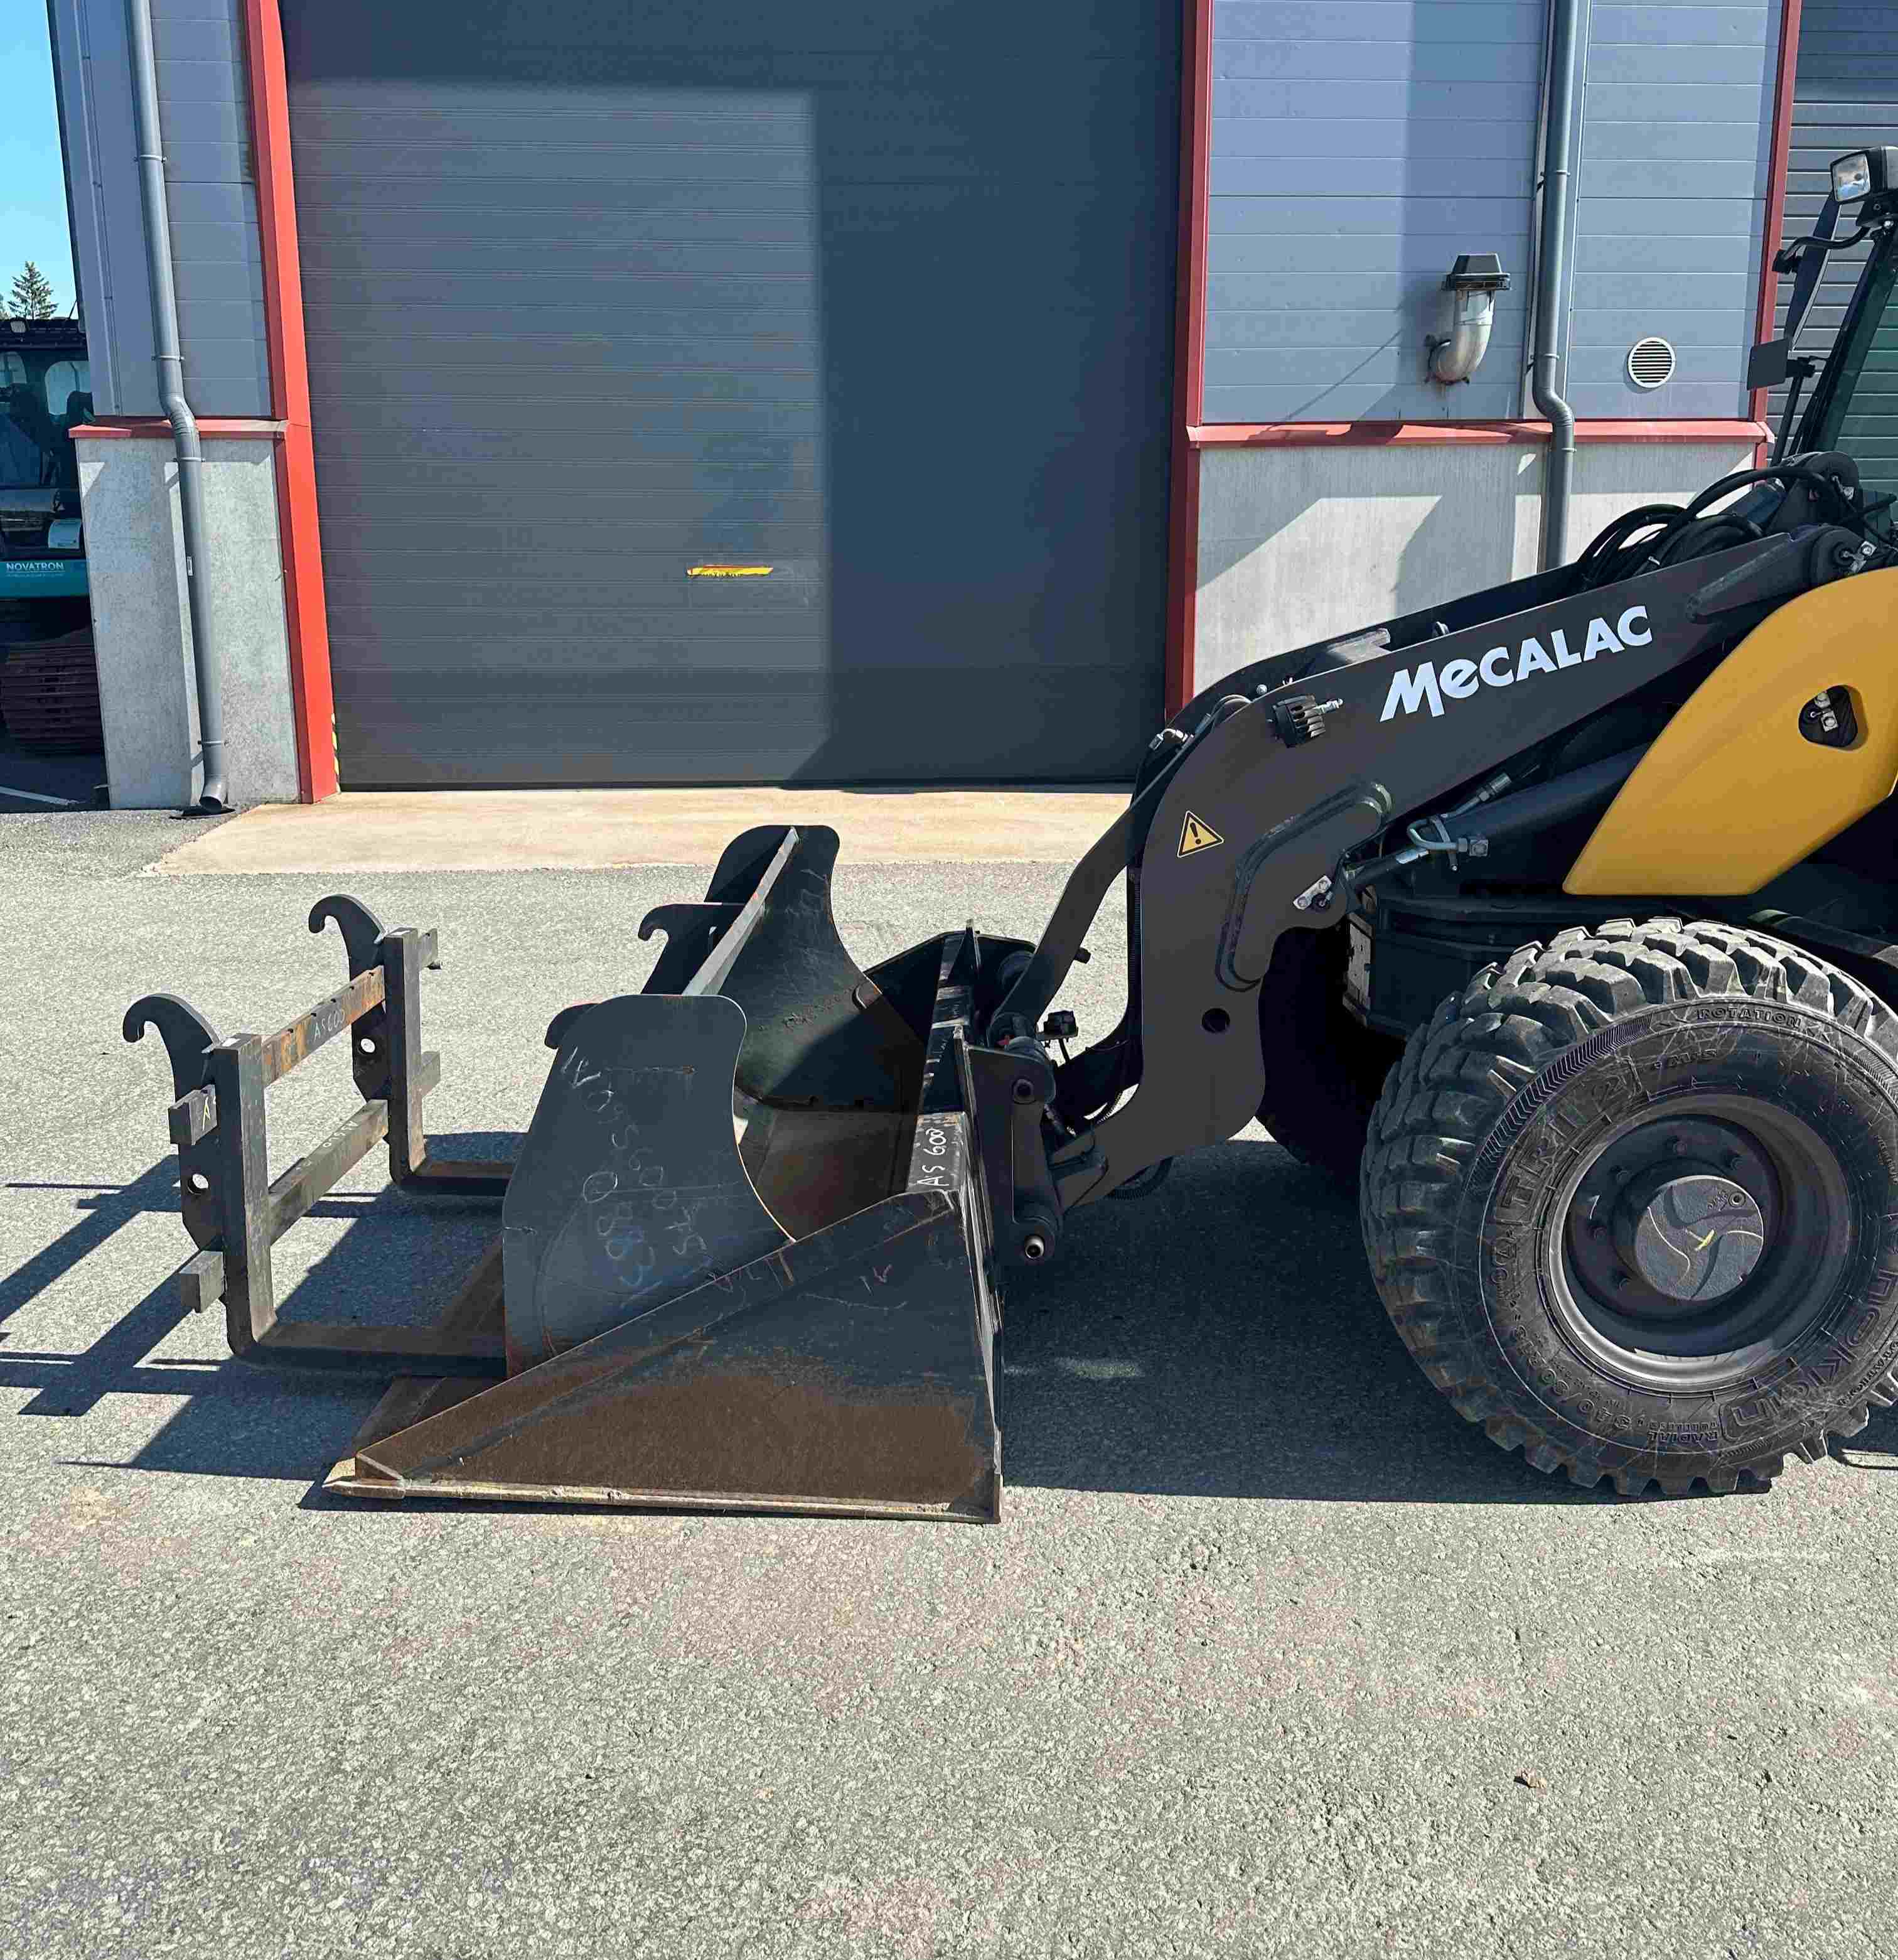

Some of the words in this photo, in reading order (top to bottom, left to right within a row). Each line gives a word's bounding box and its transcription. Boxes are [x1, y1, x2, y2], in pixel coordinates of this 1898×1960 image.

[6, 562, 65, 571] NOVATRON
[1697, 1007, 1801, 1028] ROTATION
[923, 1128, 946, 1156] 600
[916, 1164, 950, 1187] AS
[1648, 1430, 1718, 1443] RADIAL
